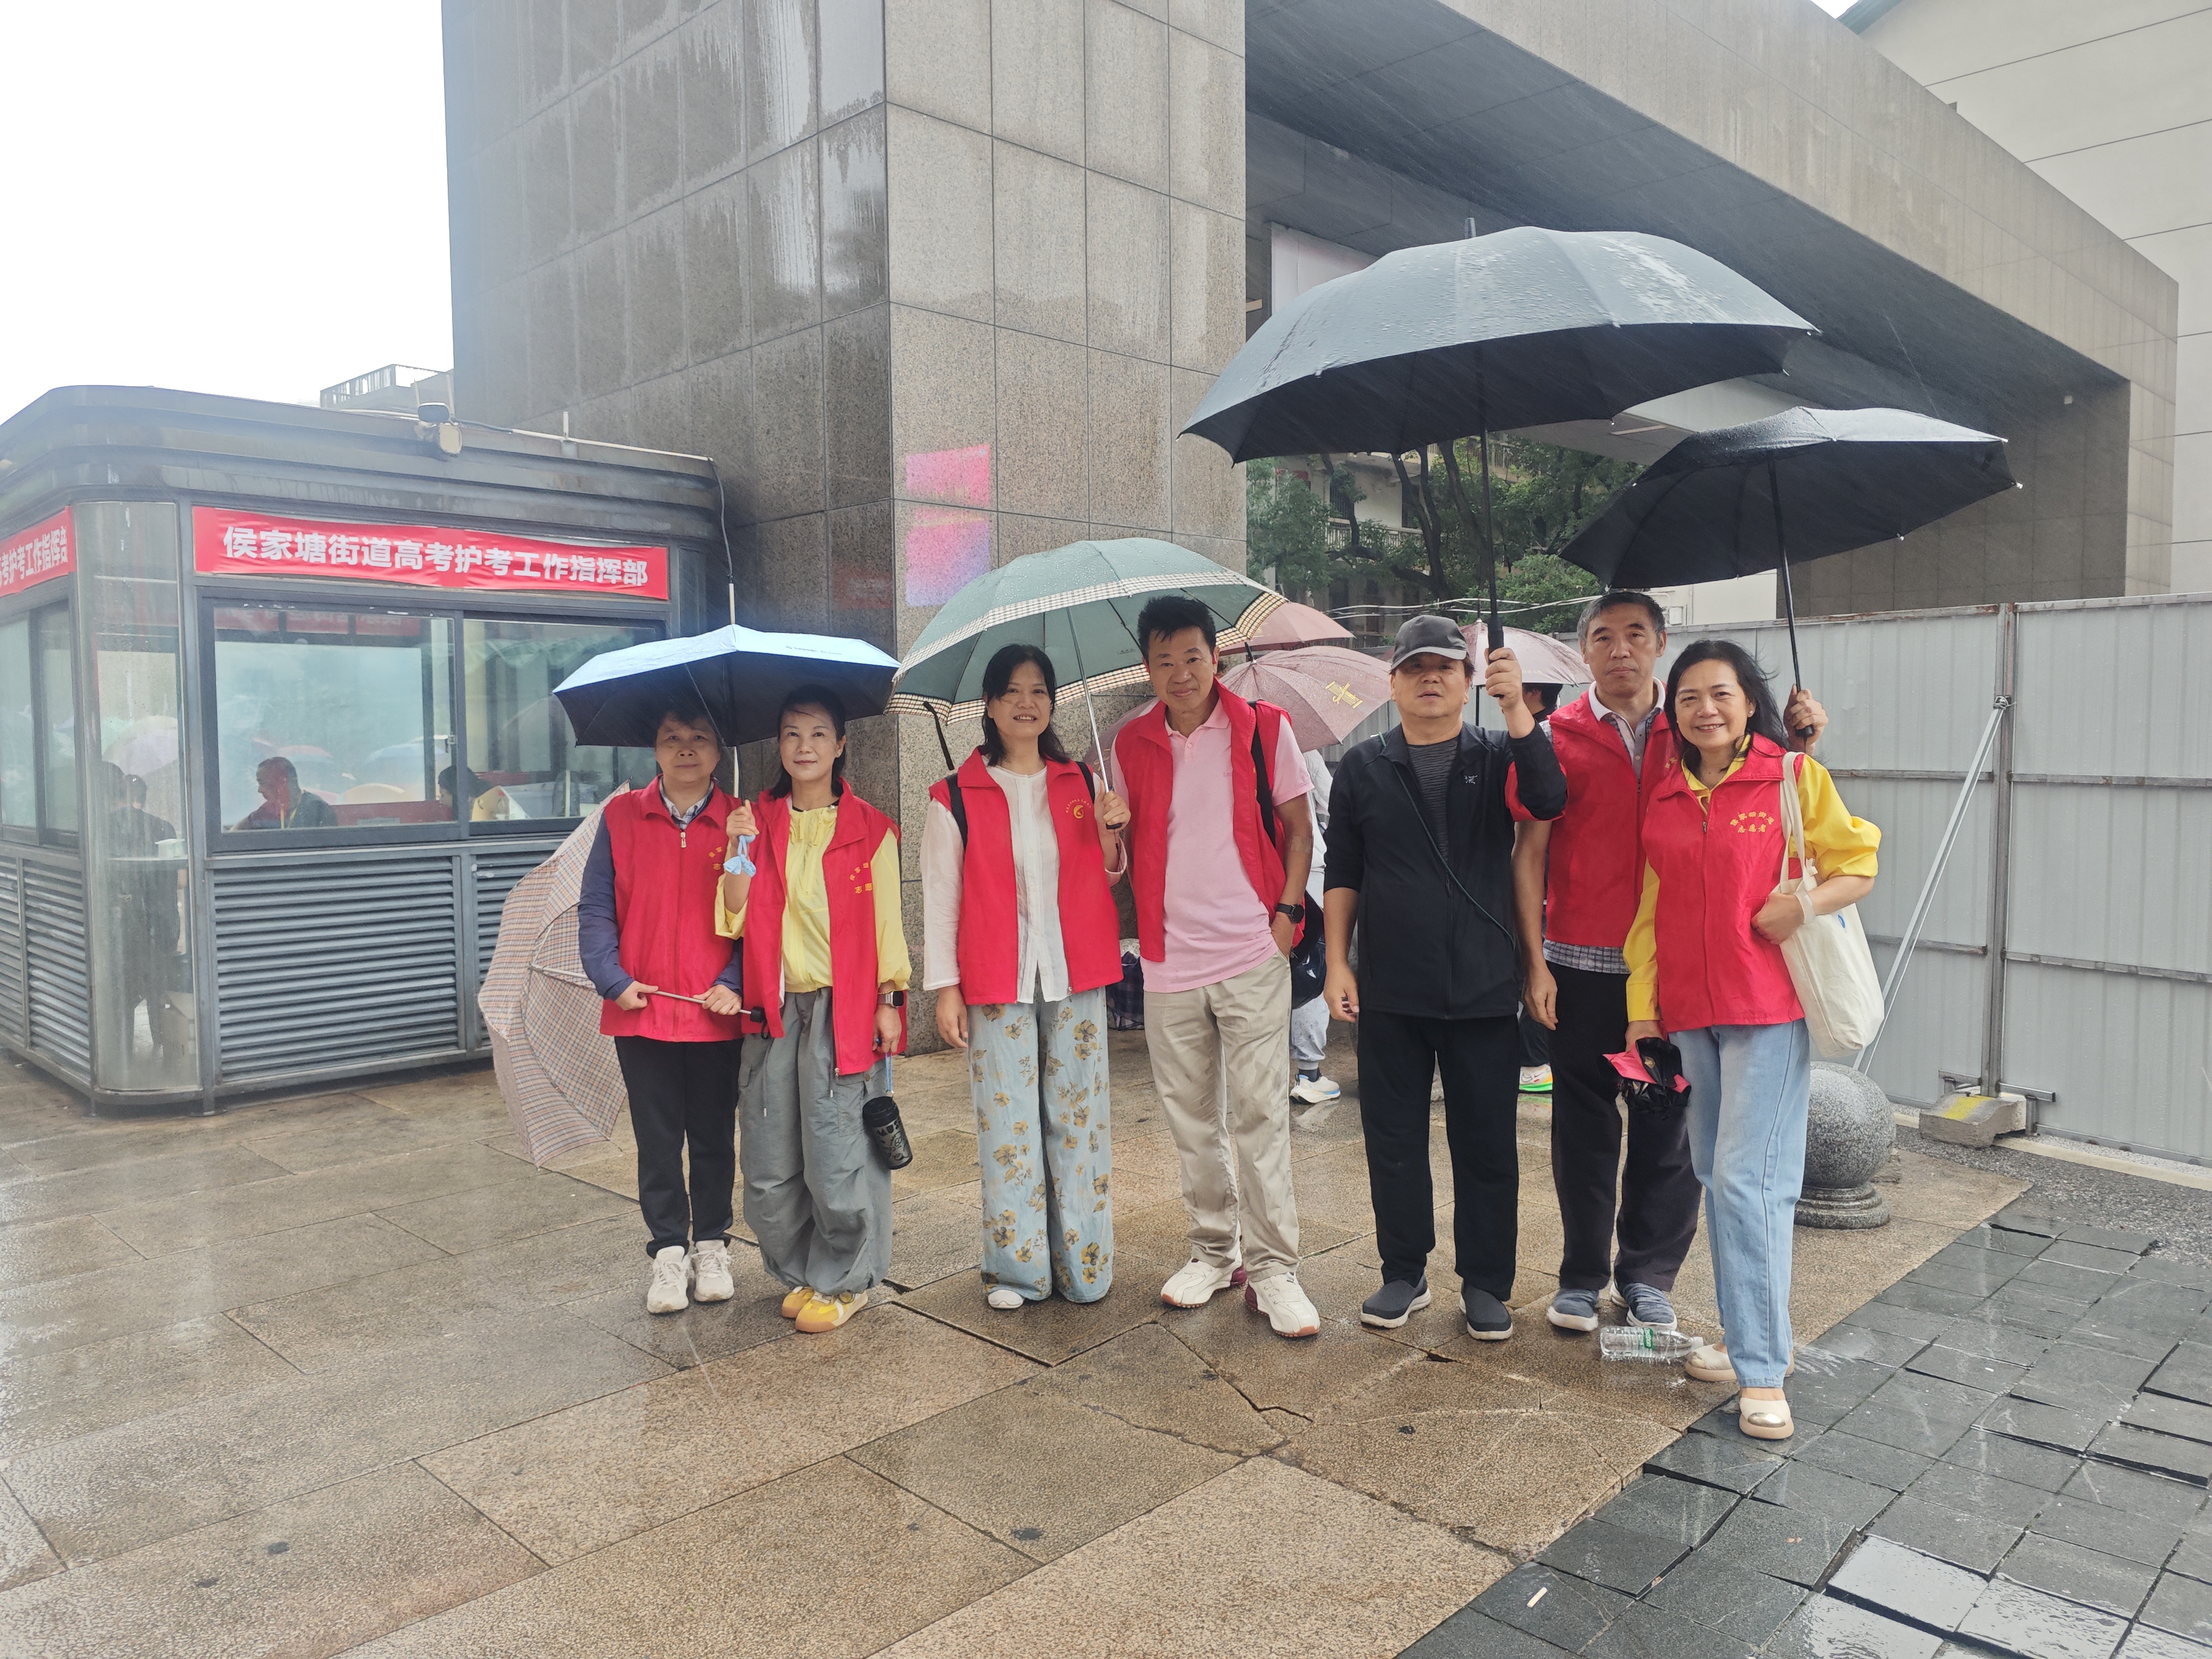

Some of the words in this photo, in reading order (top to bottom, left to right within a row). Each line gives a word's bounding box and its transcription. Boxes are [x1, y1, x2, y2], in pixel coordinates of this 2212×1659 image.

[0, 525, 68, 587] 考护考工作指挥部
[223, 525, 649, 586] 侯家塘街道高考护考工作指挥部
